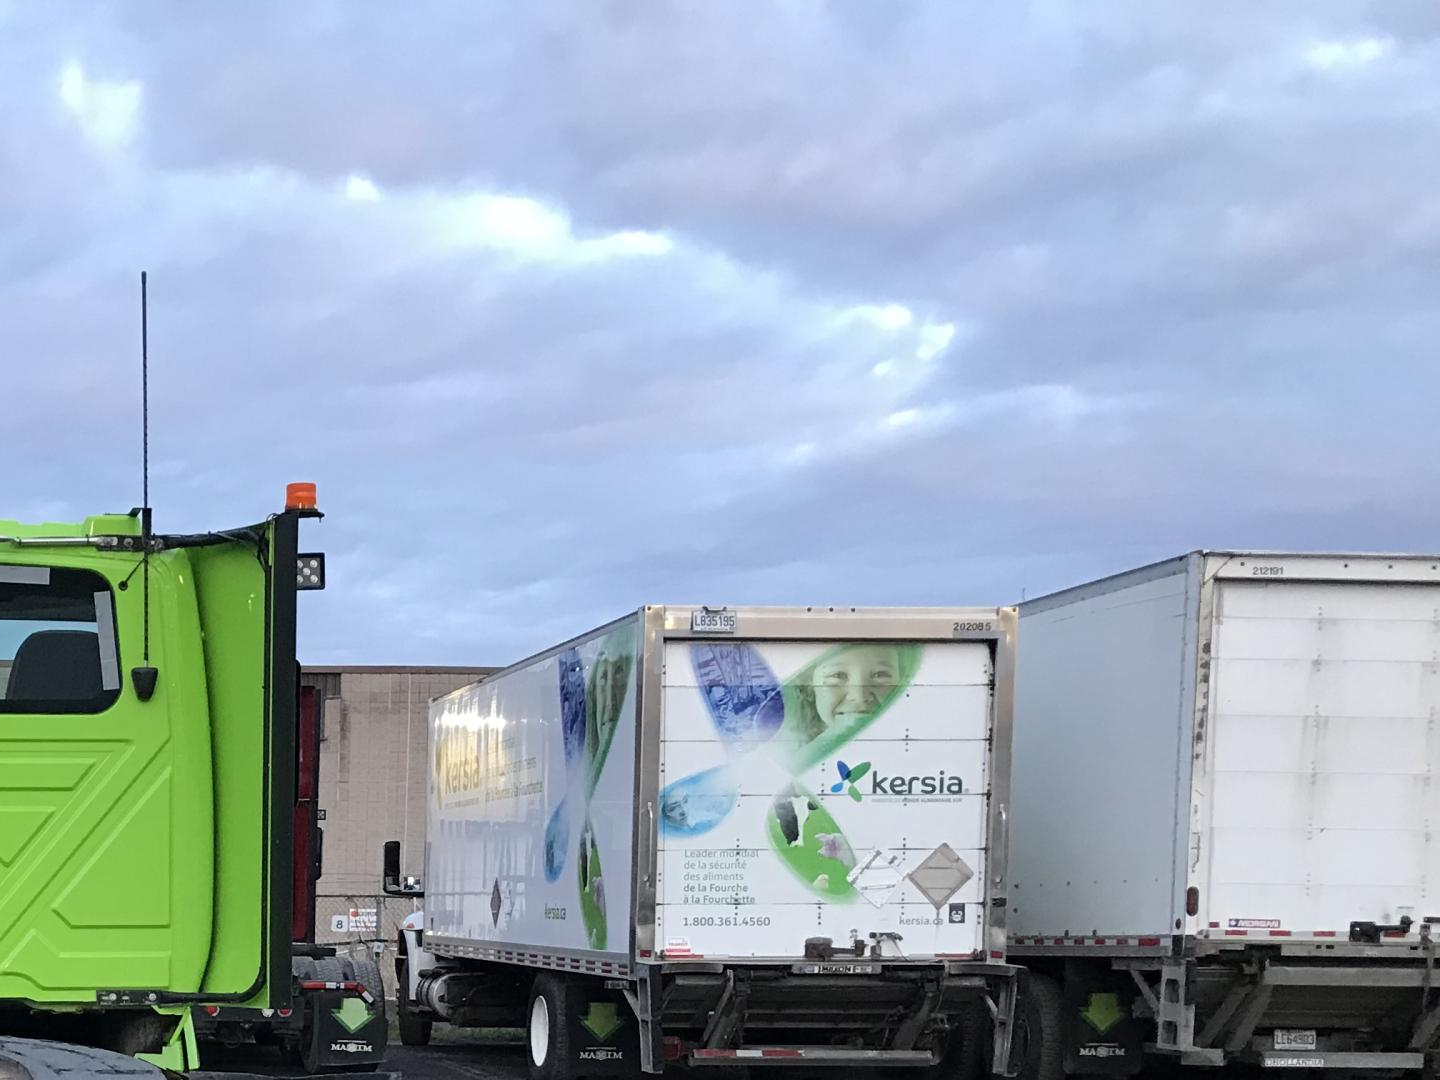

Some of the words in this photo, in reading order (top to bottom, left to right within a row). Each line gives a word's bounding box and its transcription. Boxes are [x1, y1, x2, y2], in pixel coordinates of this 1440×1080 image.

[1252, 566, 1284, 575] 212191
[872, 770, 963, 794] kersia
[684, 849, 716, 858] Leader
[683, 860, 695, 869] de
[698, 860, 707, 869] la
[709, 860, 747, 869] sécurité
[683, 872, 700, 881] des
[702, 872, 744, 881] aliments
[683, 883, 696, 892] de
[698, 883, 707, 892] la
[709, 883, 749, 892] Fourche
[691, 894, 700, 904] la
[336, 920, 343, 929] 8
[683, 917, 771, 926] 1.800.361.4560
